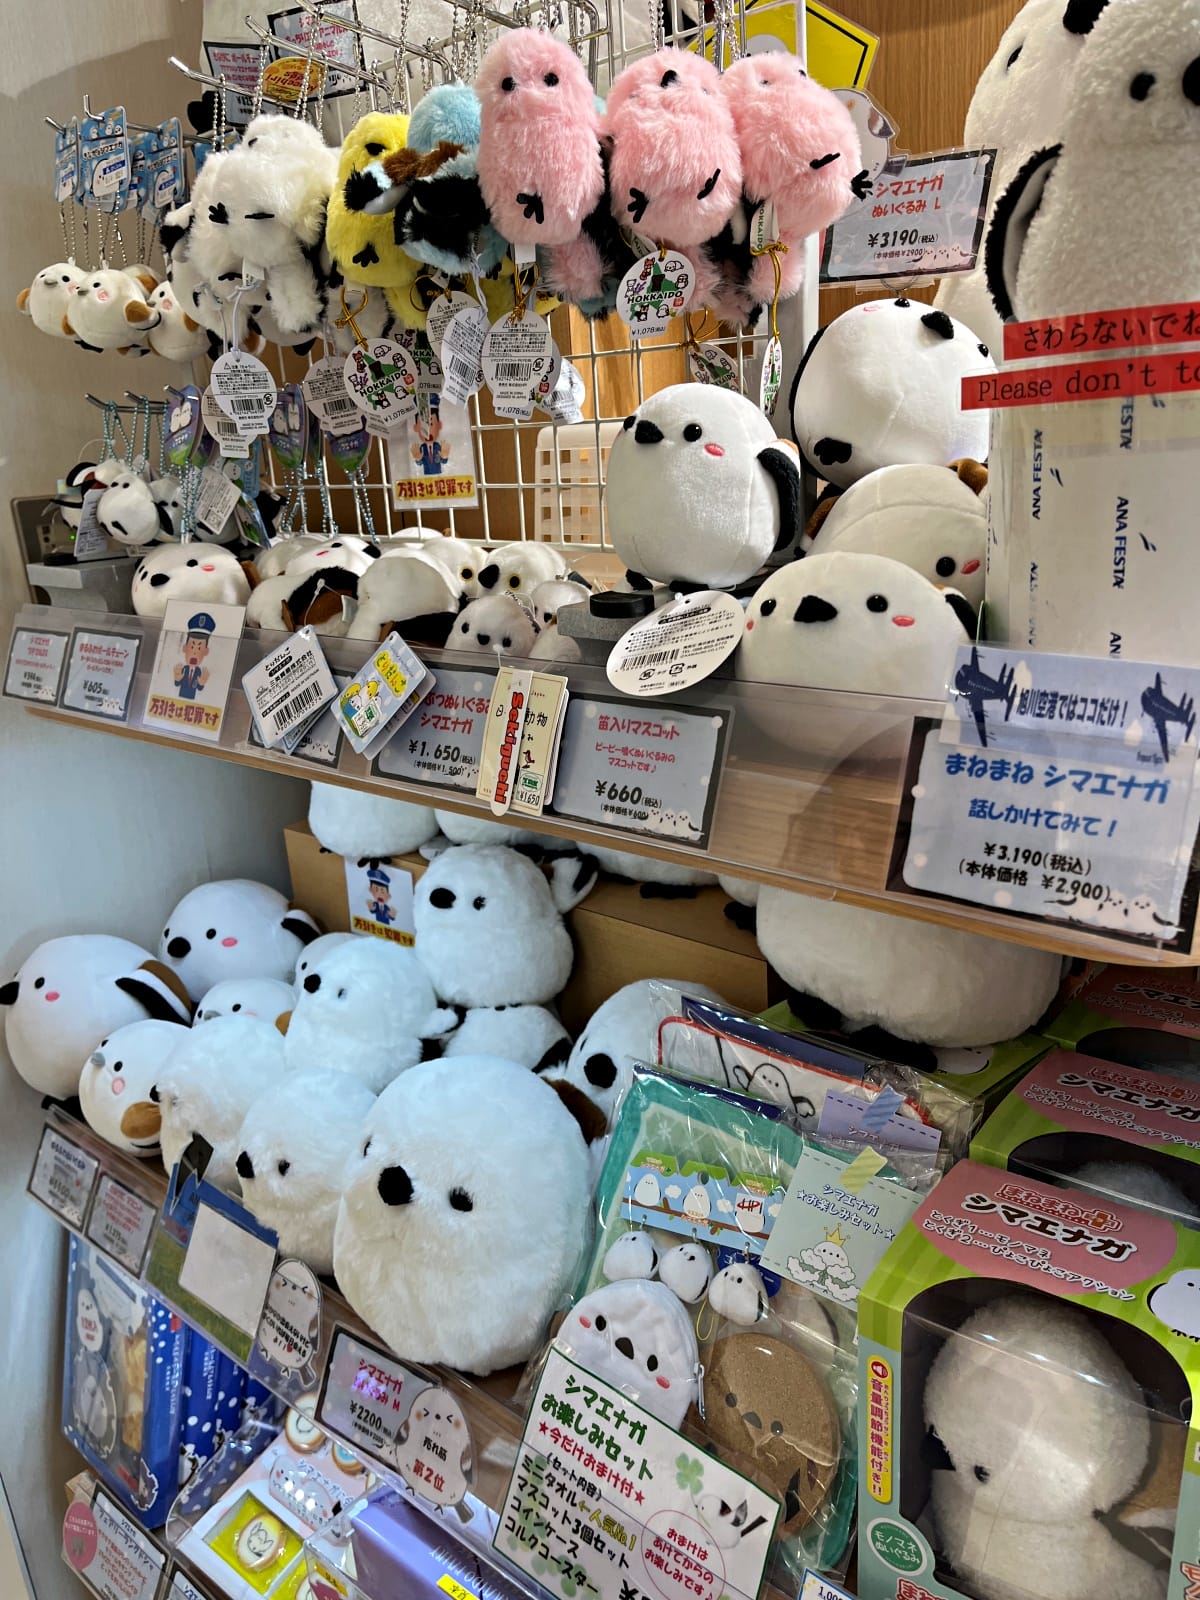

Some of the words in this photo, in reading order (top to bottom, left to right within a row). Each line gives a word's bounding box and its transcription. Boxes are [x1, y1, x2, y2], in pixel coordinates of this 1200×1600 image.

[876, 173, 945, 198] シマエナガ
[872, 200, 927, 218] ぬいぐるみ
[627, 290, 683, 304] HOKKAIDO
[1024, 307, 1200, 352] さわらないでね
[359, 368, 408, 397] HOKKAIDO
[978, 378, 1052, 402] Please
[1033, 429, 1043, 483] FESTA
[397, 478, 473, 498] 万引きは犯罪です
[1032, 486, 1042, 520] ANA
[1115, 496, 1129, 532] ANA
[1112, 536, 1127, 589] FESTA
[1109, 632, 1122, 658] AN
[150, 698, 219, 726] 万引きは犯罪です
[420, 713, 473, 735] シマエナガ
[598, 715, 680, 741] 笛入りマスコット
[494, 692, 524, 804] Sekiguchi
[945, 753, 1034, 784] まねまね
[1044, 765, 1171, 803] シマエナガ
[823, 1184, 879, 1217] シマエナガ
[964, 1194, 1135, 1260] シマエナガ
[359, 1359, 403, 1394] シマエナガ
[564, 1375, 648, 1446] シマエナガ
[422, 1435, 448, 1462] 売れ筋
[541, 1393, 653, 1481] お楽しみセット
[521, 1454, 578, 1508] ミニタオル
[510, 1496, 579, 1560] コインケース
[517, 1475, 630, 1569] マスコット3個セット
[505, 1516, 599, 1594] コルクコースター
[667, 1528, 709, 1561] おまけは
[875, 1530, 918, 1553] モノマネ
[875, 1542, 921, 1564] ぬいぐるみ
[653, 1536, 715, 1585] あけてからの
[818, 1586, 844, 1600] 1,00
